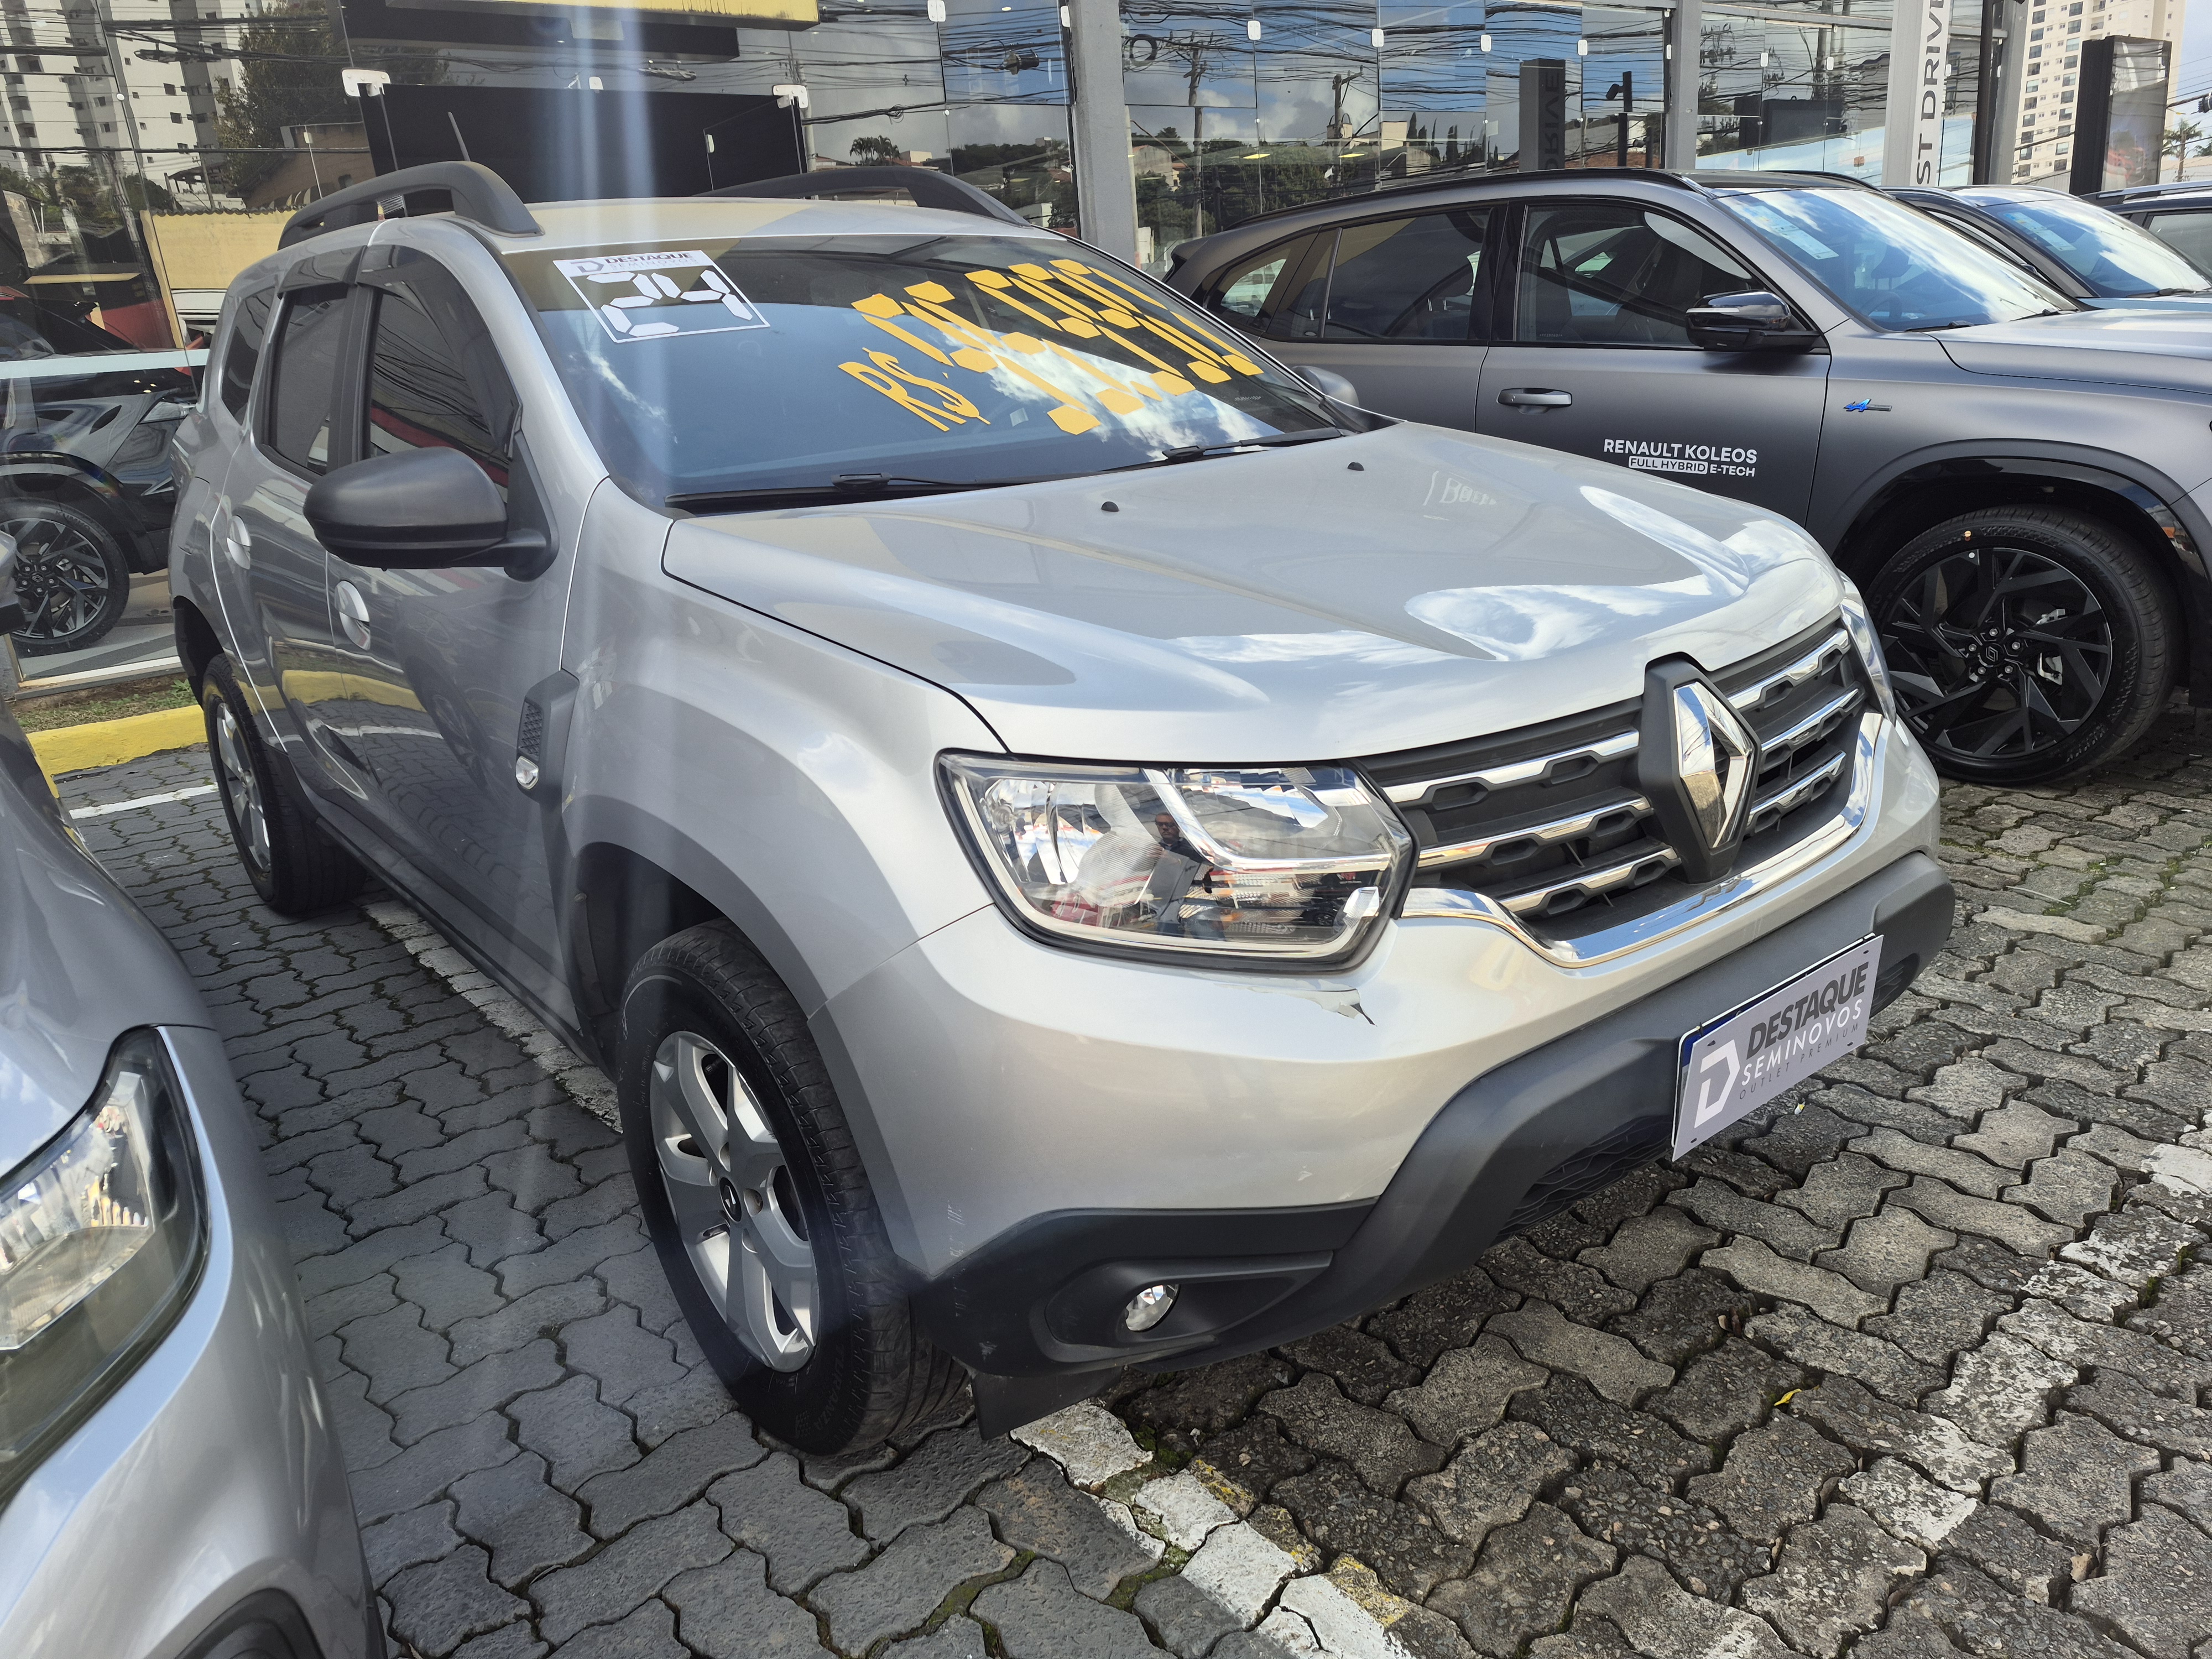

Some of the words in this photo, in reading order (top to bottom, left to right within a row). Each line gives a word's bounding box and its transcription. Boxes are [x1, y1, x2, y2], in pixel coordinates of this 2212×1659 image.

[604, 252, 693, 264] DESTAQUE
[586, 269, 753, 337] 24
[851, 259, 1265, 436] 95.990
[837, 347, 991, 432] R$
[1604, 439, 1682, 458] RENAULT
[1684, 444, 1758, 464] KOLEOS
[1630, 458, 1658, 469] FULL
[1661, 460, 1706, 472] HYBRID
[1709, 463, 1756, 477] E-TECH
[1741, 998, 1863, 1086] SEMINOVOS
[1746, 962, 1869, 1060] DESTAQUE
[1739, 1062, 1790, 1100] OUTLET
[1800, 1023, 1859, 1063] PREMIUM
